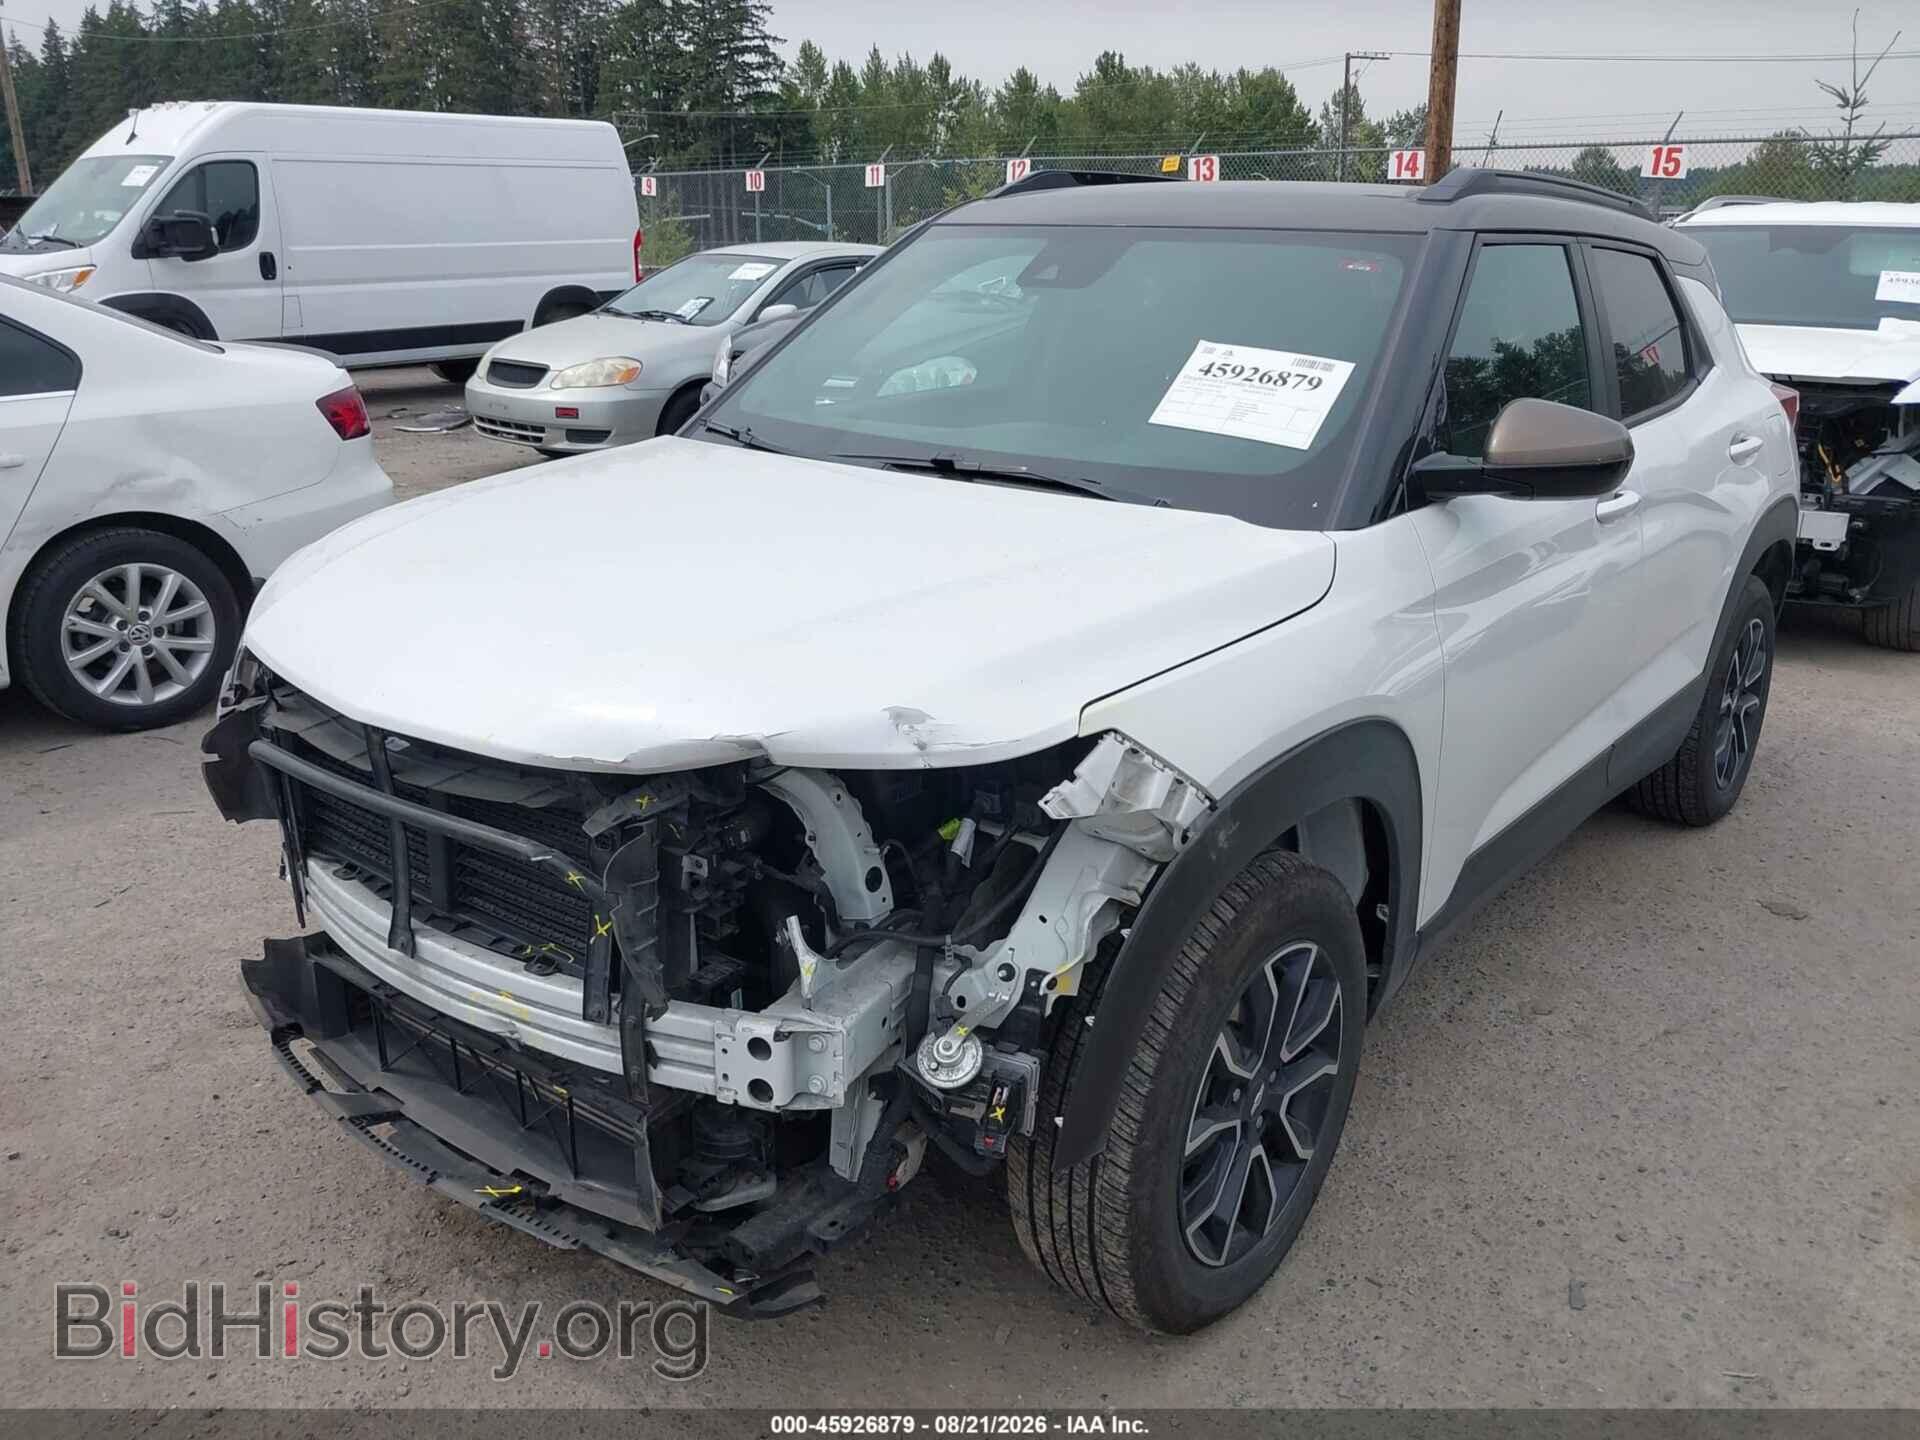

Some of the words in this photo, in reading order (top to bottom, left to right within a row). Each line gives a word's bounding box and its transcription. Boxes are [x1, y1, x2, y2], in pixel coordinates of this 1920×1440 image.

[1010, 160, 1027, 182] 12
[1193, 157, 1214, 181] 13
[1395, 151, 1419, 177] 14
[1652, 146, 1683, 177] 15
[645, 178, 653, 194] 9
[749, 172, 762, 190] 10
[870, 166, 881, 185] 11
[1198, 361, 1324, 392] 45926879
